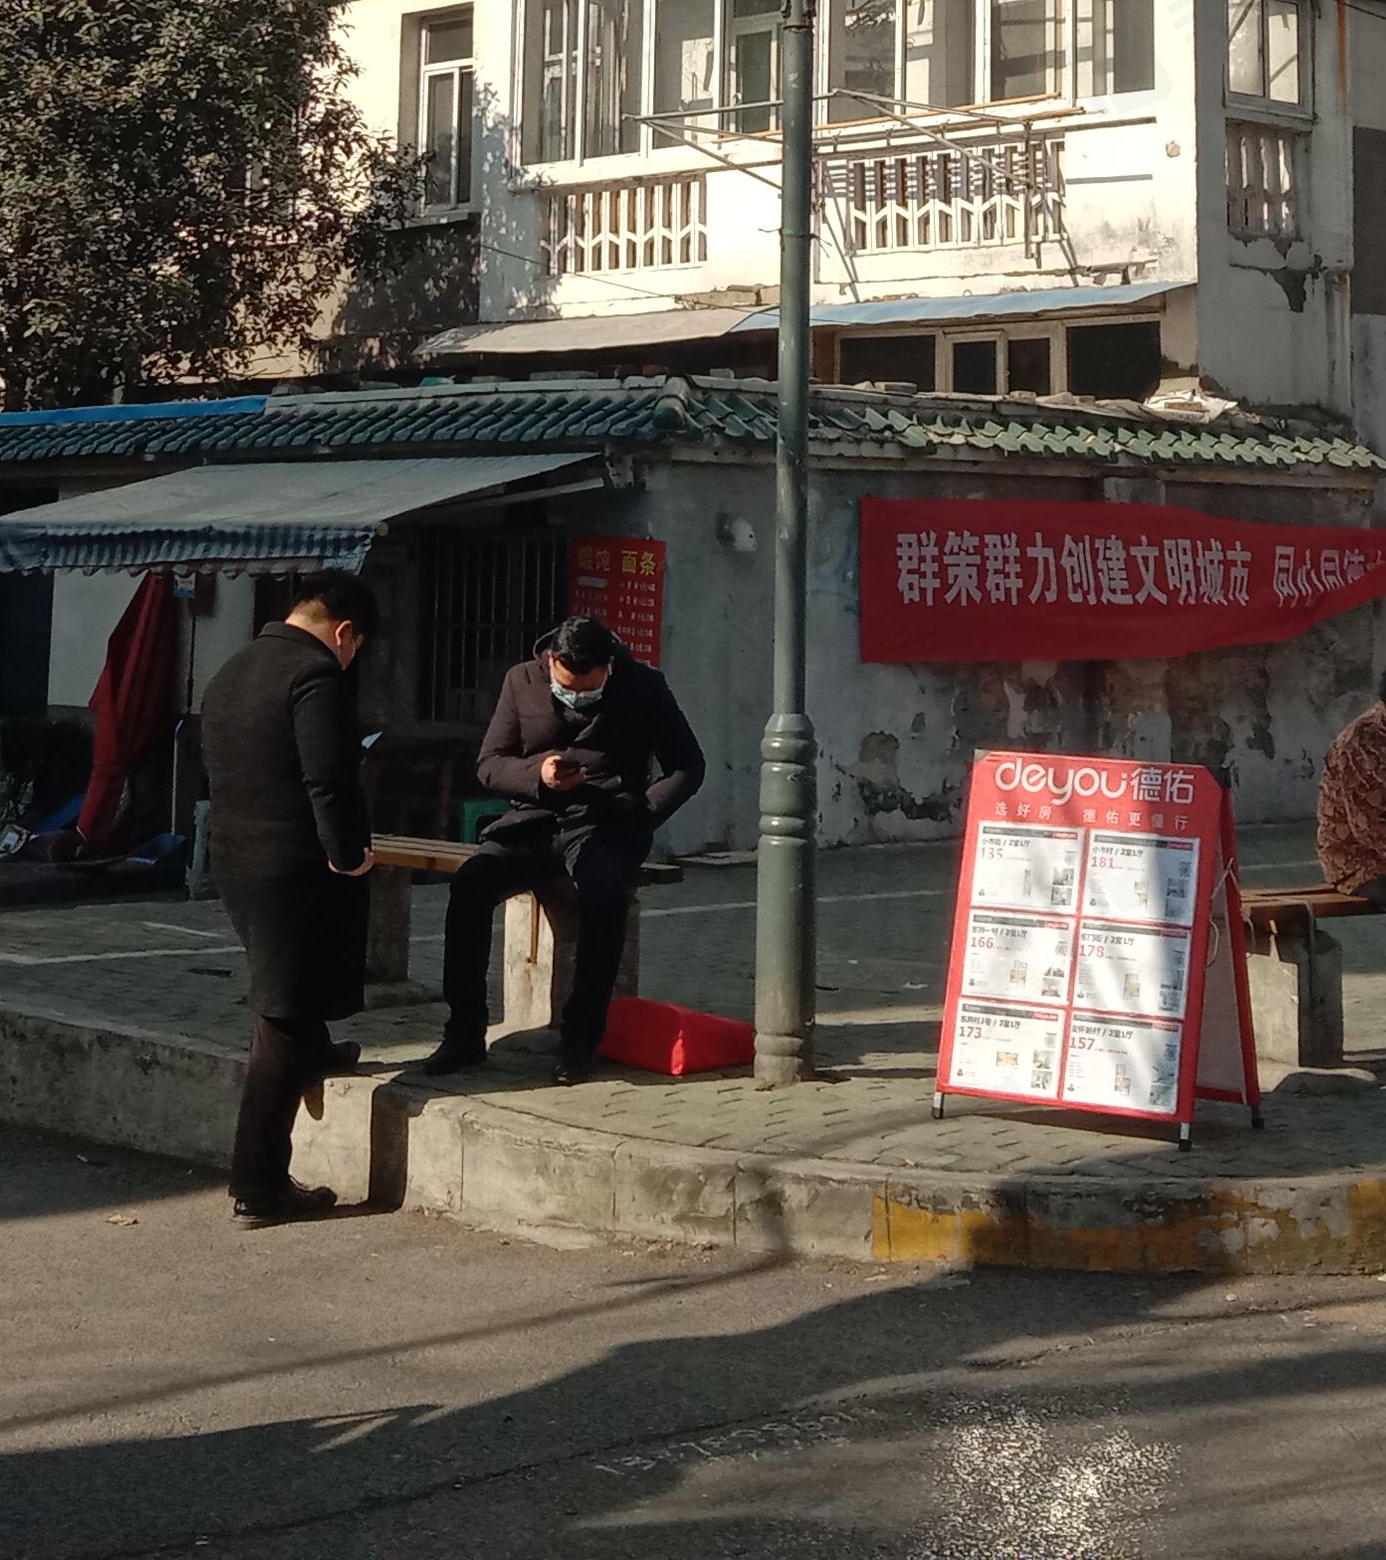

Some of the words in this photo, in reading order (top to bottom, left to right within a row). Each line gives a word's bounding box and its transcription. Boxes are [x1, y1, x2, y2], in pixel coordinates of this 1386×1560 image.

[621, 550, 656, 576] 面条
[895, 530, 1252, 608] 群策群力创建文明城市
[995, 758, 1127, 805] deyou
[1130, 767, 1194, 804] 德佑
[995, 802, 1053, 821] 选好房
[980, 847, 1004, 860] 135
[1091, 856, 1114, 869] 181
[971, 937, 994, 949] 166
[959, 1026, 982, 1039] 173
[1069, 1036, 1095, 1050] 157
